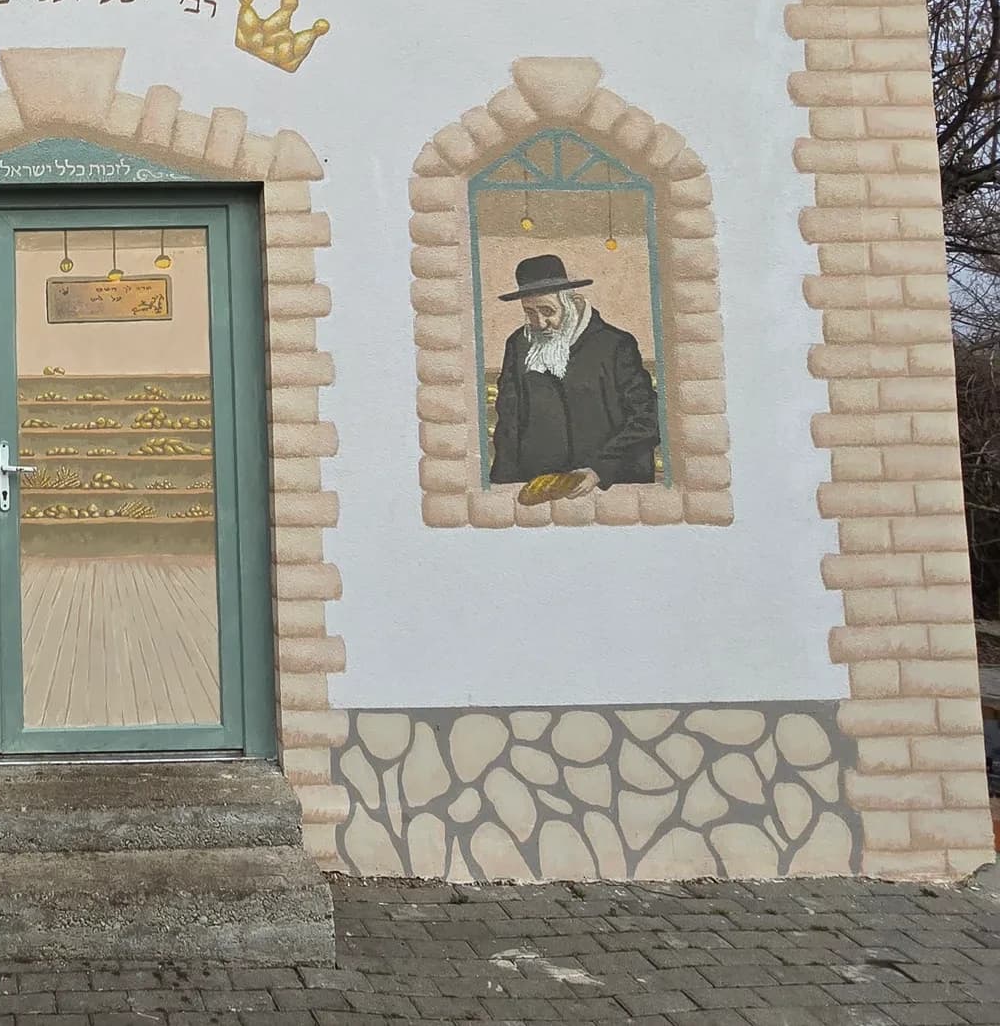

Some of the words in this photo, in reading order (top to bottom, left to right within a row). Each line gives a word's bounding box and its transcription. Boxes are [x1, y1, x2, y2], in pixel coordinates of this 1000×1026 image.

[0, 159, 53, 178] ישראל
[55, 159, 85, 177] כלל
[89, 158, 131, 177] לזכות
